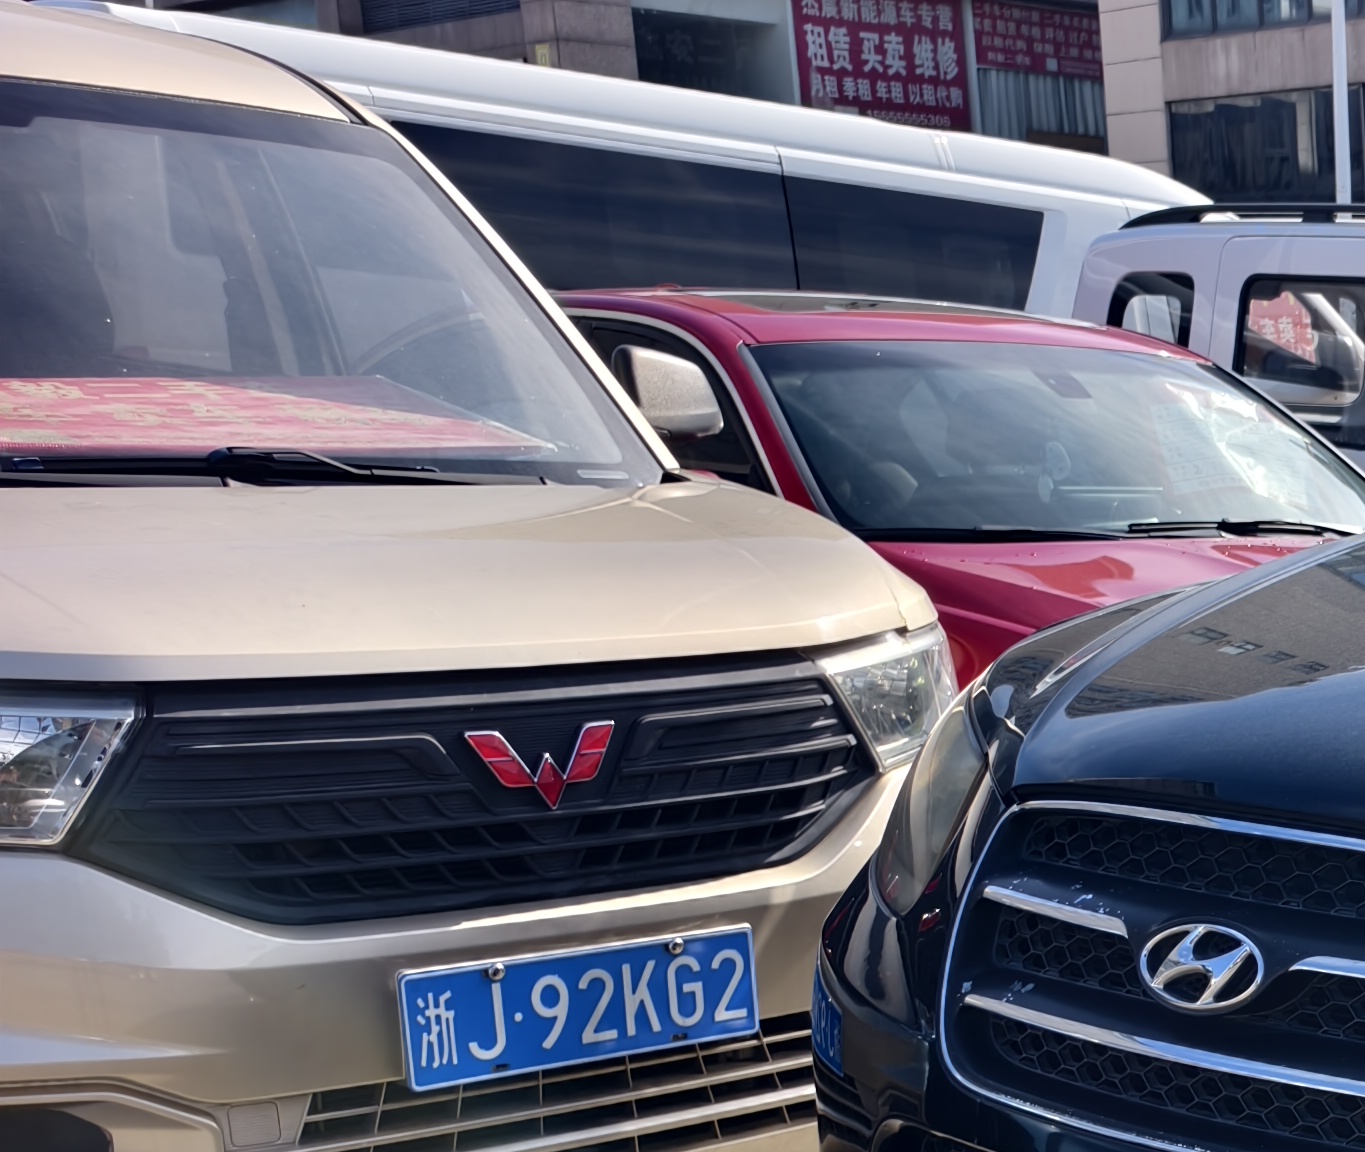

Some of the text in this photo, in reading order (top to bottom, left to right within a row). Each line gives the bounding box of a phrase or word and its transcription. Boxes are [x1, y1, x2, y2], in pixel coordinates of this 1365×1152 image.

[803, 23, 959, 81] 租赁 买卖 维修
[812, 72, 963, 109] 月租 季租 年租 以租代购
[416, 947, 749, 1070] 浙J·92KG2
